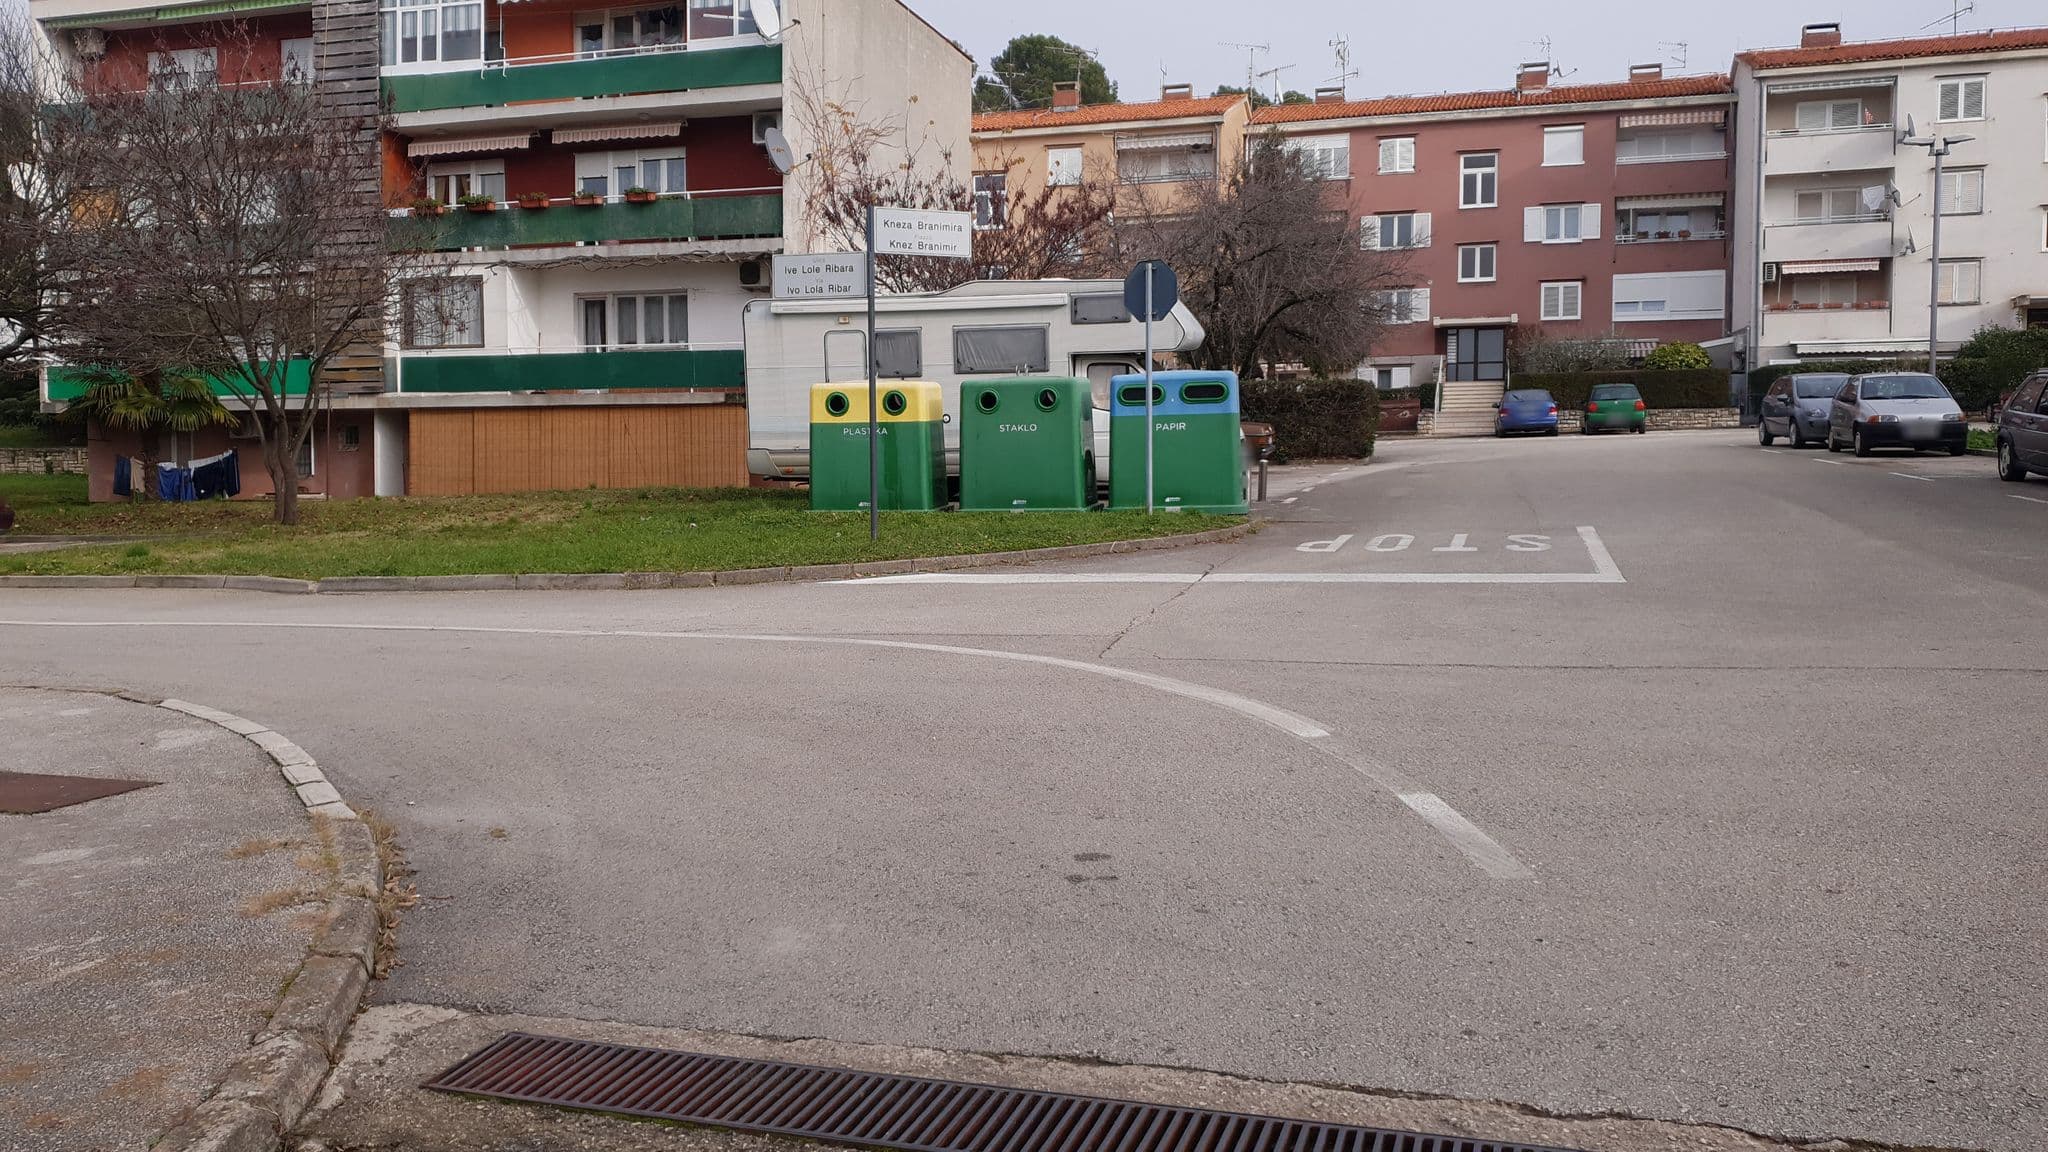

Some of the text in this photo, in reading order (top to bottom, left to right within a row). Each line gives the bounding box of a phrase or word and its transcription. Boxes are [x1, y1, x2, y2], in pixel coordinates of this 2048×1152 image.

[883, 219, 963, 232] Kneza Branimira
[889, 240, 957, 252] Knez Branimir
[784, 264, 854, 275] Ive Lole Ribara
[787, 284, 852, 295] Ivo Lola Ribar
[843, 427, 888, 436] PLASTKA
[999, 423, 1038, 433] STAKLO
[1155, 422, 1187, 432] PAPIR
[1295, 533, 1552, 553] STOP
